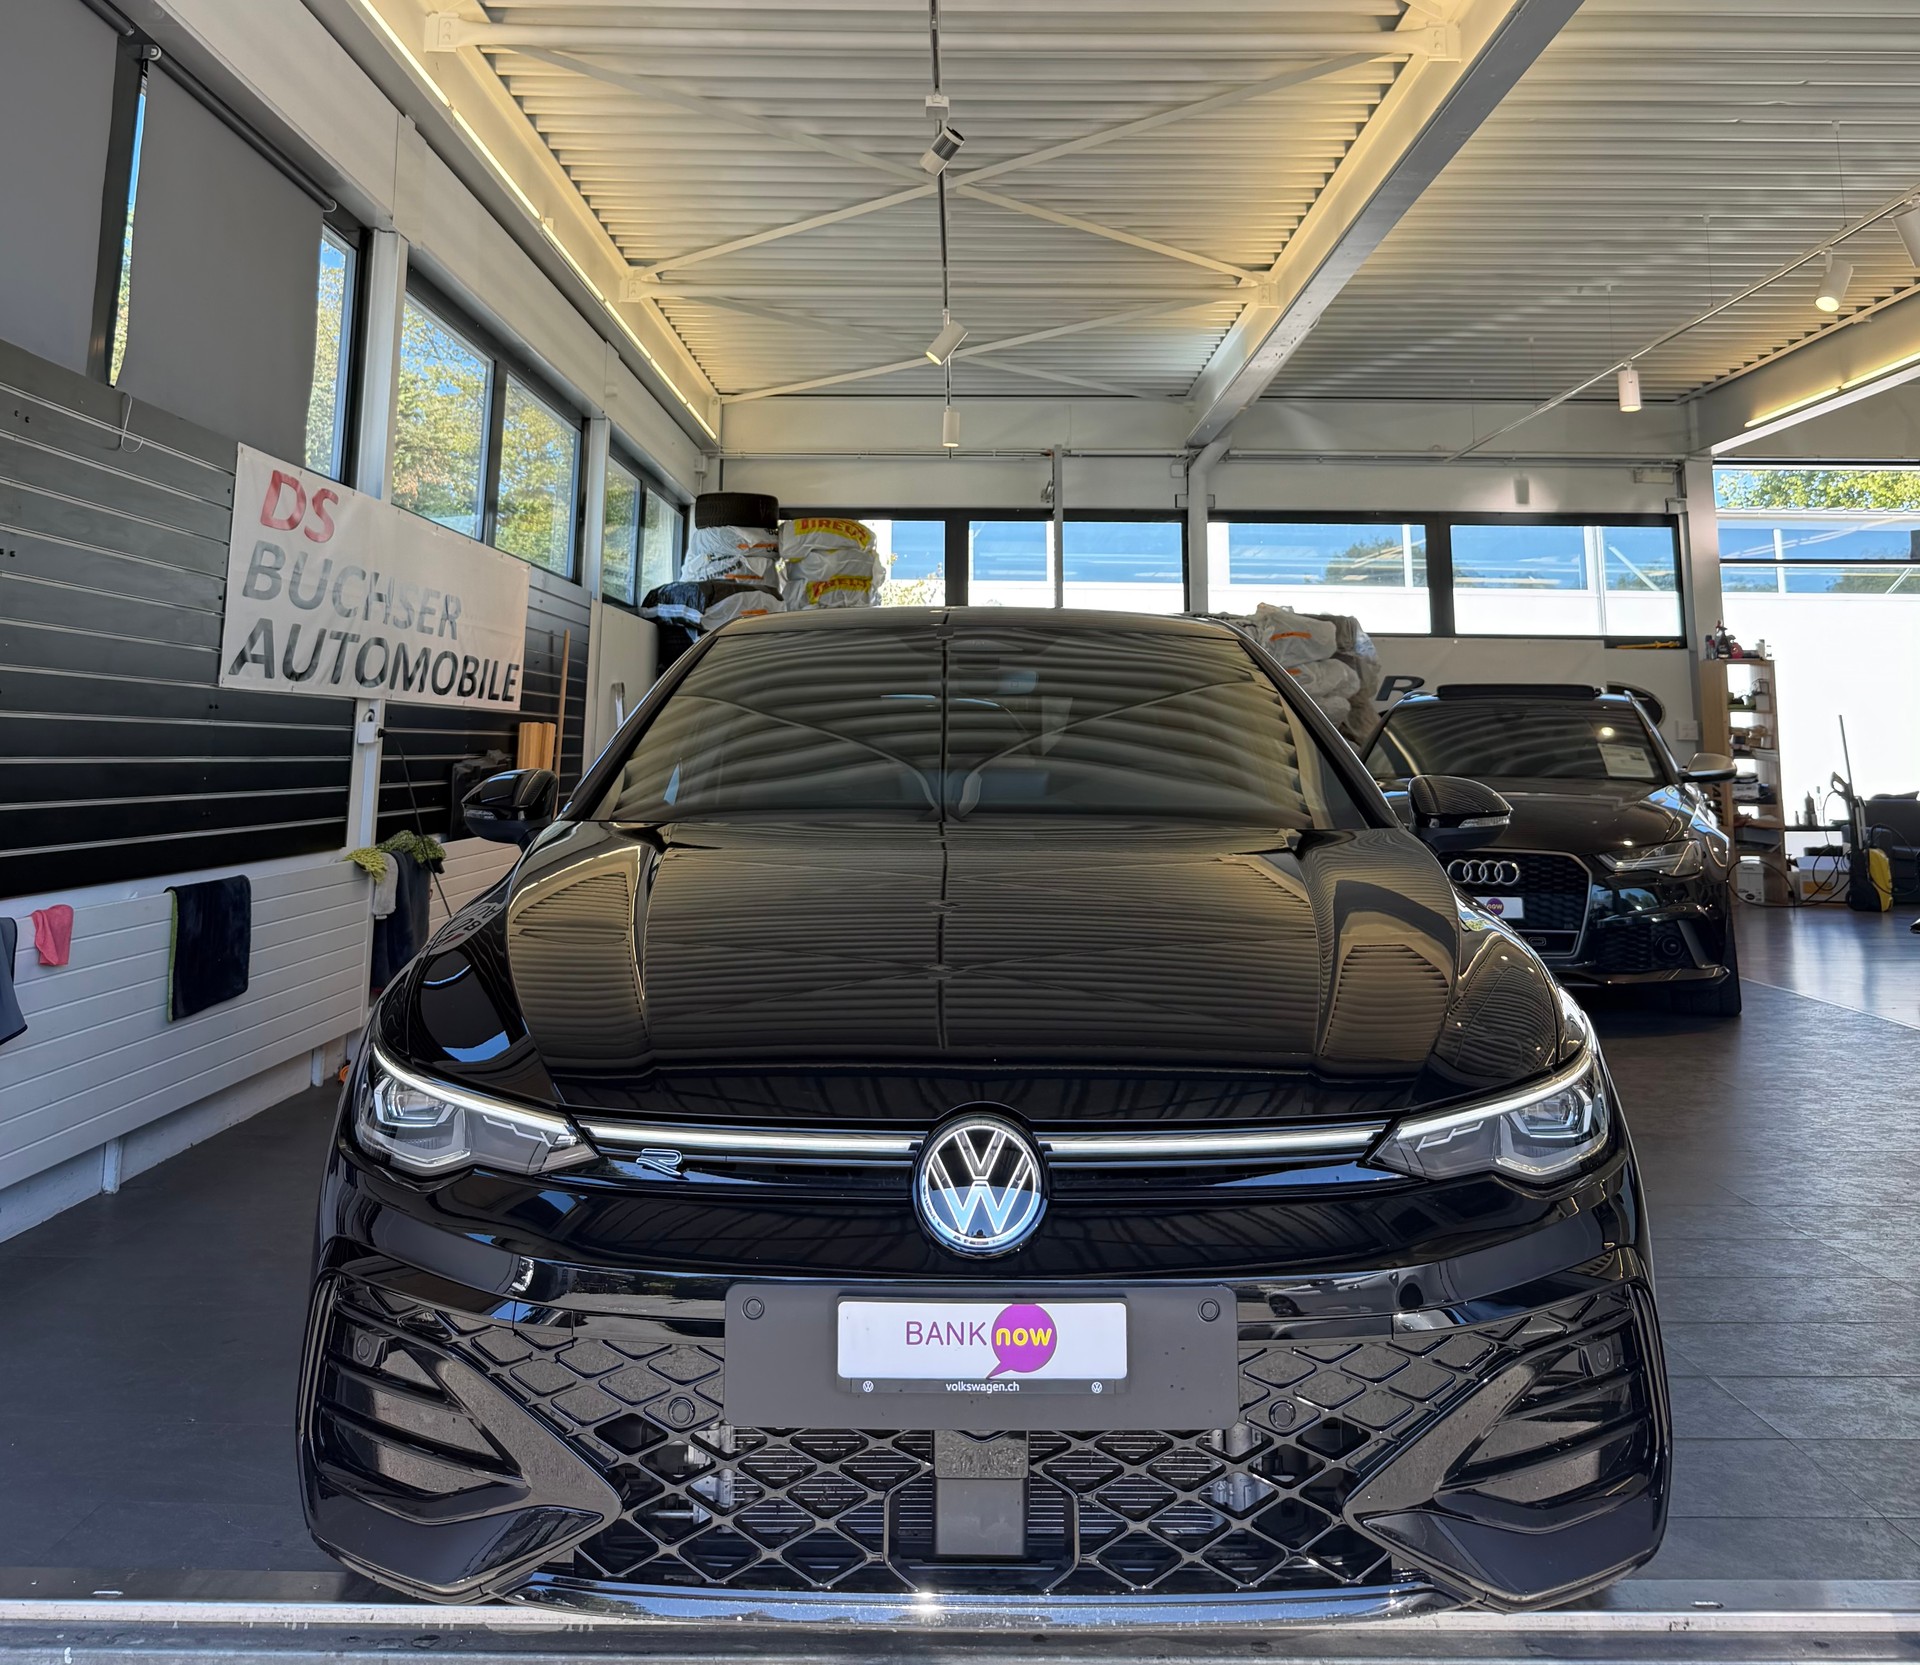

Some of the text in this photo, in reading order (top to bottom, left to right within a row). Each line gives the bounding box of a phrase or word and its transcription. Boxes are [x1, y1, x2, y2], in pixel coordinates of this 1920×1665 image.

[260, 469, 339, 543] DS
[242, 540, 463, 640] BUCHSER
[228, 617, 521, 703] AUTOMOBILE
[636, 1148, 683, 1176] R
[905, 1320, 1053, 1347] BANK now
[945, 1380, 1020, 1394] volkswagen.ch
